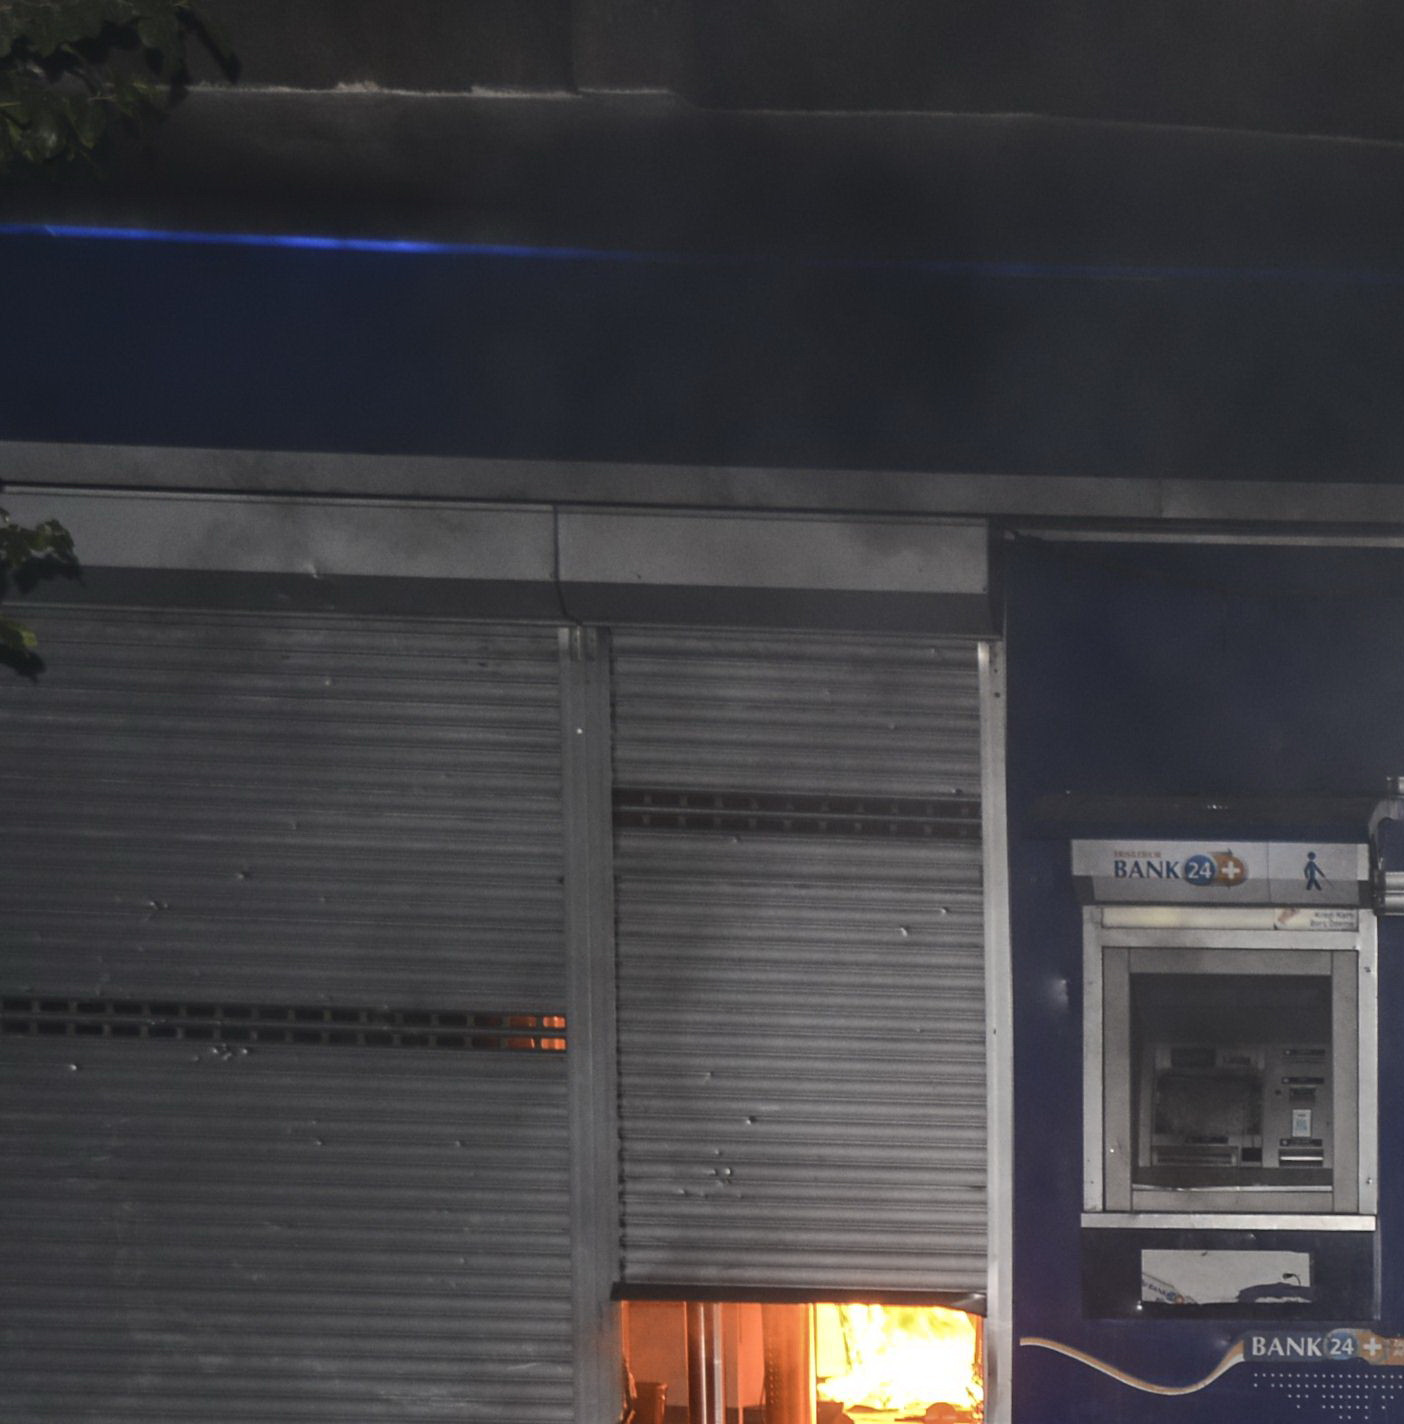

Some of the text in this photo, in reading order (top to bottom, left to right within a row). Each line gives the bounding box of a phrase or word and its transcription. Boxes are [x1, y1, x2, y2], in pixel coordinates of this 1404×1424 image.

[1113, 860, 1213, 879] BANK 24
[1252, 1336, 1355, 1357] BANK 24
